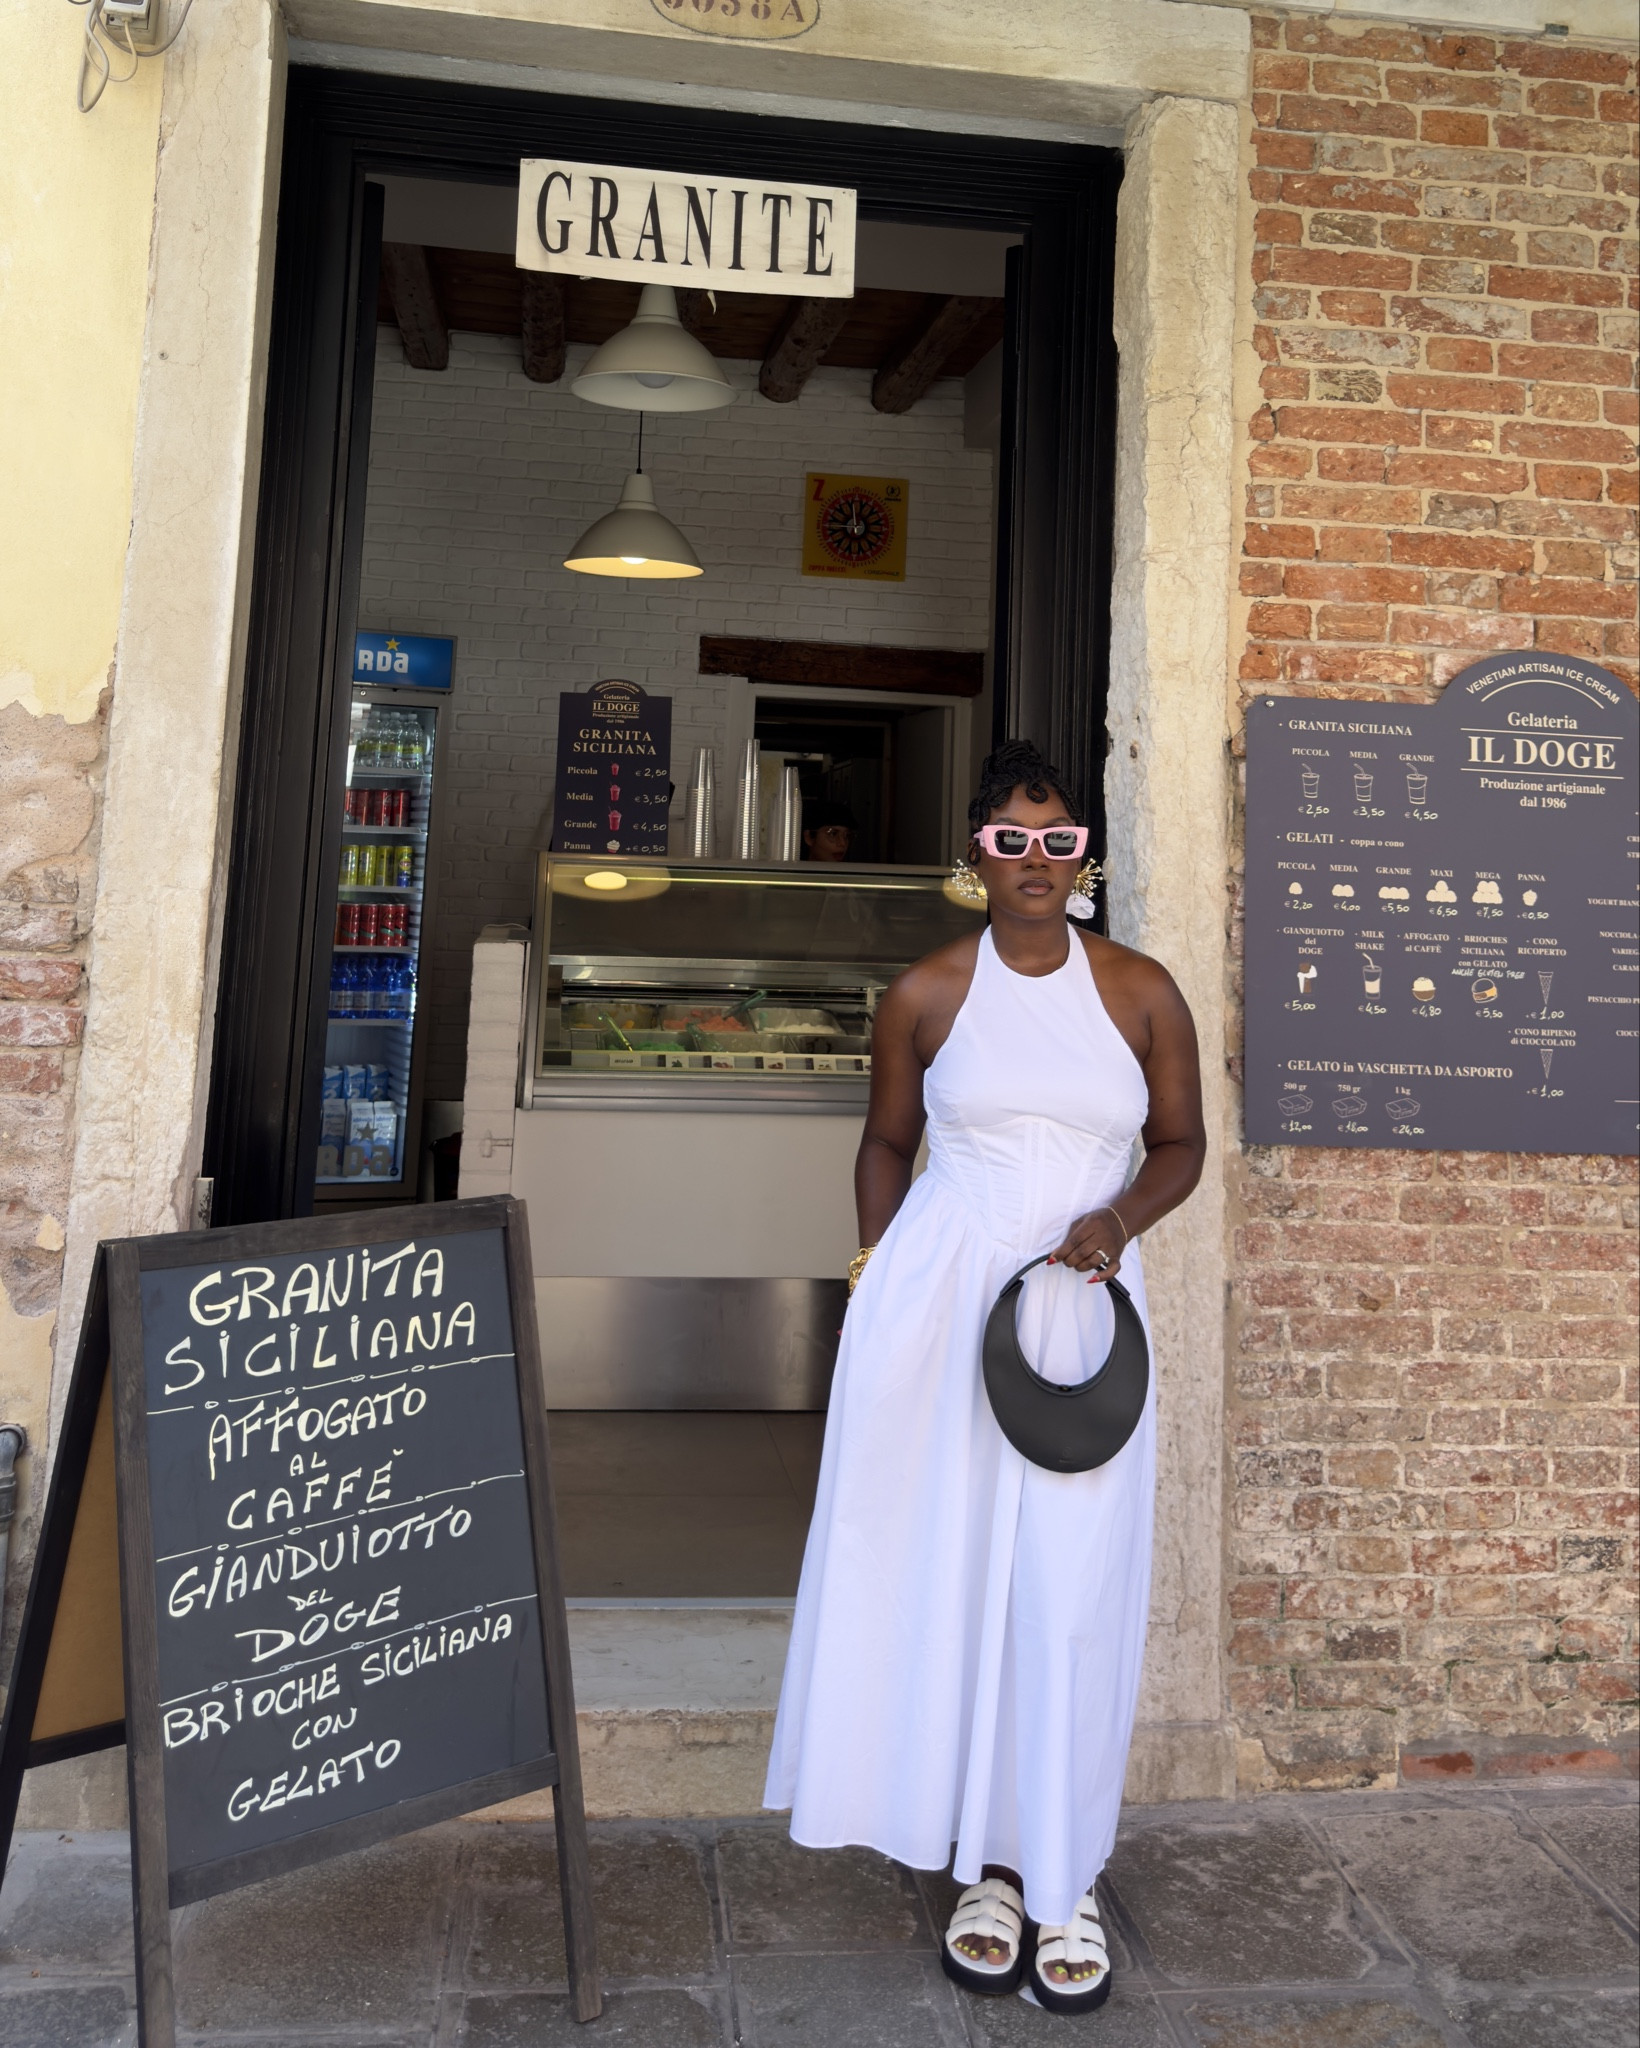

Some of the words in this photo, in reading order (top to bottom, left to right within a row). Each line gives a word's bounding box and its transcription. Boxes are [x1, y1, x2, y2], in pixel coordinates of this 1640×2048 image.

[537, 171, 833, 276] GRANITE
[1466, 666, 1516, 694] VENETIAN
[1518, 663, 1564, 675] ARTISAN
[1566, 669, 1584, 682] ICE
[1585, 676, 1620, 705] CREAM
[607, 703, 640, 712] DOGE
[1507, 711, 1578, 729] Gelateria
[1288, 719, 1345, 732] GRANITA
[1347, 723, 1412, 736] SICILIANA
[579, 728, 652, 742] GRANITA
[573, 742, 656, 756] SICILIANA
[1292, 748, 1330, 757] PICCOLA
[1468, 735, 1505, 764] IL
[1513, 738, 1616, 770] DOGE
[1350, 751, 1378, 760] MEDIA
[1399, 754, 1435, 763] GRANDE
[567, 766, 598, 776] Piccola
[1480, 777, 1543, 792] Produzione
[1546, 781, 1606, 796] artigianale
[566, 792, 594, 801] Media
[1520, 796, 1537, 808] dal
[1541, 797, 1567, 809] 1986
[564, 819, 597, 829] Grande
[1286, 832, 1334, 844] GELATI
[1350, 838, 1375, 848] coppa
[1384, 840, 1404, 848] cono
[564, 841, 591, 850] Panna
[1278, 861, 1316, 871] PICCOLA
[1330, 864, 1358, 873] MEDIA
[1375, 866, 1412, 875] GRANDE
[1430, 869, 1453, 878] MAXI
[1475, 871, 1501, 880] MEGA
[1517, 873, 1546, 882] PANNA
[1587, 897, 1617, 906] YOGURT
[1283, 927, 1345, 937] GIANDUIOTTO
[1361, 930, 1385, 939] MILK
[1403, 932, 1450, 941] AFFOGATO
[1599, 930, 1638, 939] NOCCIOLA
[1464, 935, 1508, 944] BRIOCHES
[1533, 937, 1558, 946] CONO
[1298, 946, 1323, 955] DOGE
[1355, 942, 1385, 951] SHAKE
[1461, 946, 1505, 956] SICILIANA
[1517, 946, 1567, 956] RICOPERTO
[1458, 960, 1471, 968] con
[1473, 960, 1508, 969] GELATO
[1587, 995, 1632, 1004] PISTACCHIO
[1514, 1028, 1540, 1036] CONO
[1541, 1028, 1577, 1037] RIPIENO
[1510, 1037, 1518, 1045] di
[1519, 1037, 1576, 1047] CIOCCOLATO
[1287, 1059, 1340, 1072] GELATO
[1343, 1062, 1354, 1073] in
[1357, 1062, 1432, 1076] VASCHETTA
[1434, 1065, 1453, 1077] DA
[1454, 1066, 1513, 1079] ASPORTO
[1283, 1082, 1297, 1090] 500
[1298, 1084, 1307, 1092] gr
[1338, 1084, 1351, 1092] 750
[1353, 1085, 1361, 1094] gr
[189, 1241, 444, 1326] GRANITA
[164, 1301, 475, 1395] SICILIANA
[209, 1382, 427, 1480] AFFOGATO
[289, 1451, 327, 1477] AL
[168, 1505, 472, 1618] GIANDUIOTTO
[287, 1588, 333, 1611] DEL
[234, 1585, 401, 1662] DOGE
[163, 1663, 340, 1749] BRIOCHE
[361, 1613, 513, 1685] SICILIANA
[291, 1707, 357, 1750] CON
[227, 1739, 401, 1821] GELATO
